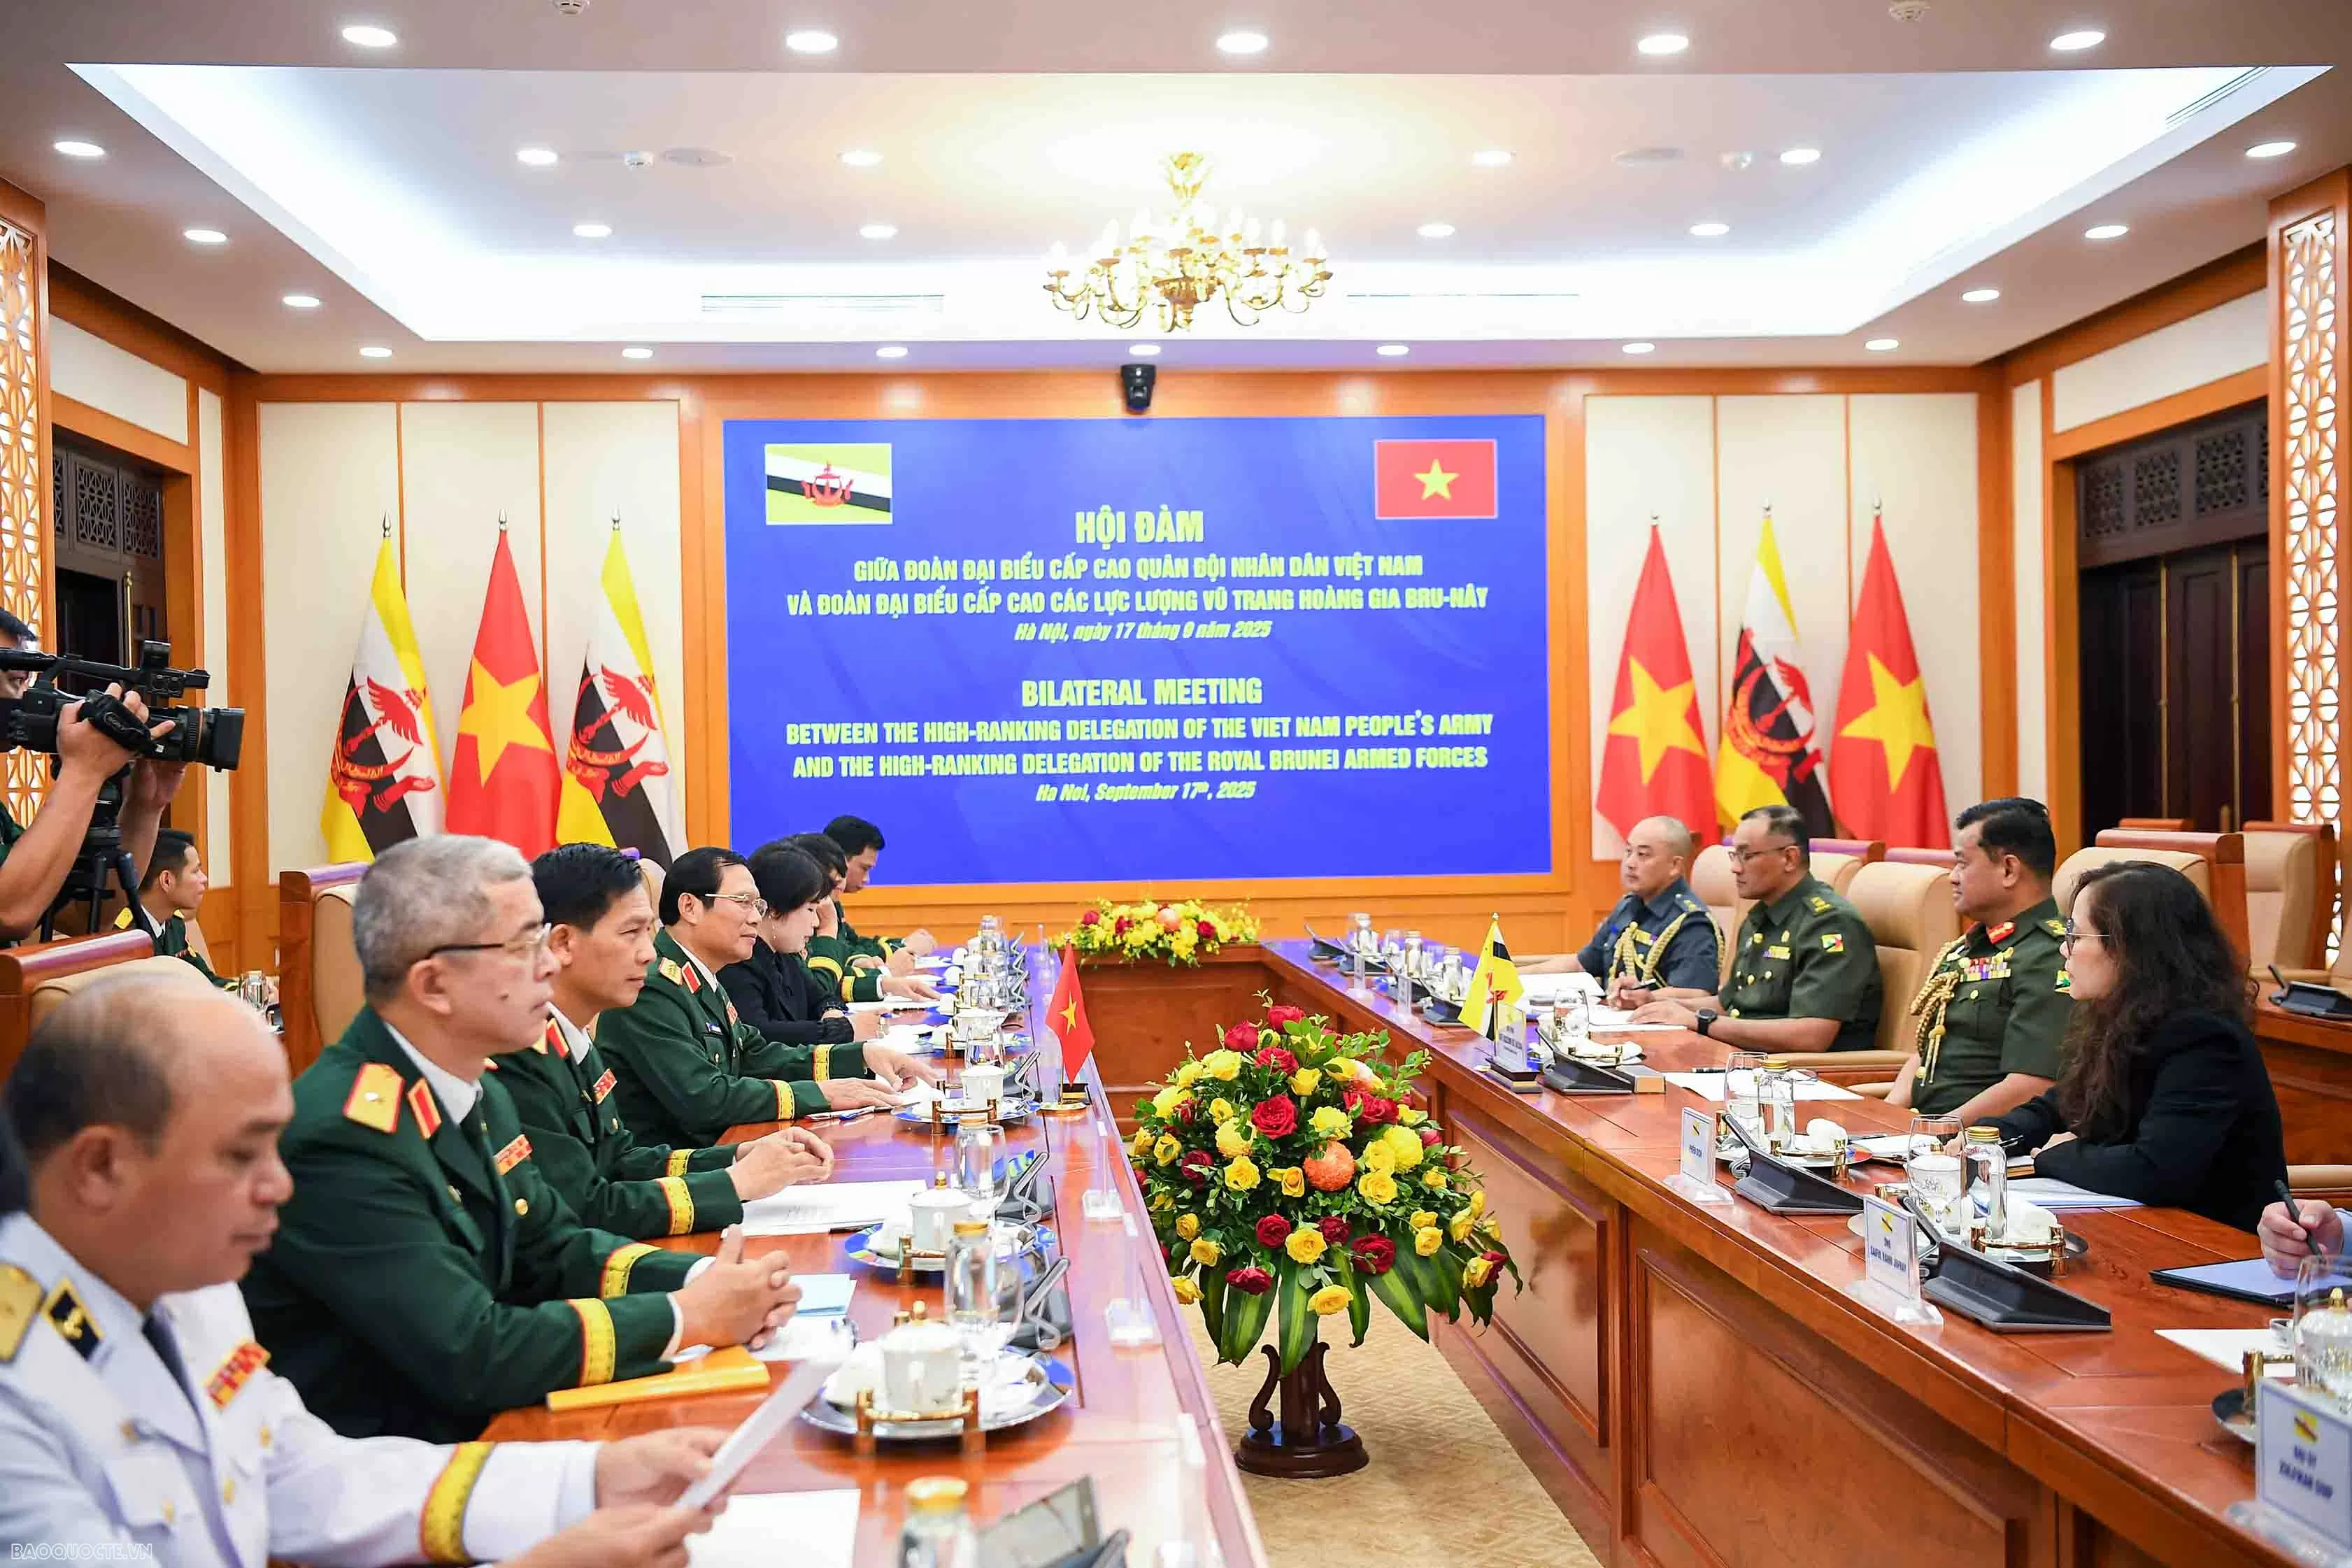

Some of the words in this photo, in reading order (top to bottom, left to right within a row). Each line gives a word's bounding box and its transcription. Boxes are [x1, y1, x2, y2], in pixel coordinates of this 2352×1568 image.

[1076, 504, 1127, 550] HỘI
[1134, 504, 1204, 543] ĐÀM
[854, 557, 900, 582] GIỮA
[904, 556, 958, 580] ĐOÀN
[962, 560, 996, 585] ĐẠI
[1000, 551, 1045, 580] BIỂU
[1050, 552, 1089, 580] CẤP
[1093, 558, 1132, 579] CAO
[1136, 554, 1190, 580] QUÂN
[1192, 553, 1227, 582] ĐỘI
[1231, 553, 1285, 578] NHÂN
[1290, 552, 1330, 577] DÂN
[1333, 551, 1374, 580] VIỆT
[1378, 555, 1423, 576] NAM
[787, 590, 813, 615] VÀ
[817, 590, 871, 615] ĐOÀN
[876, 593, 909, 618] ĐẠI
[914, 585, 958, 614] BIỂU
[963, 586, 1002, 613] CẤP
[1007, 592, 1046, 613] CAO
[1050, 587, 1090, 613] CÁC
[1094, 589, 1131, 615] LỰC
[1135, 589, 1198, 615] LƯỢNG
[1203, 586, 1228, 611] VŨ
[1232, 589, 1295, 610] TRANG
[1299, 585, 1364, 610] HOÀNG
[1369, 588, 1402, 609] GIA
[1405, 583, 1489, 608] BRU-NÂY
[1014, 623, 1037, 640] Hà
[1073, 622, 1113, 641] ngày
[1116, 622, 1136, 639] 17
[1136, 621, 1181, 641] tháng
[1195, 621, 1232, 638] năm
[1232, 620, 1274, 638] 2025
[1022, 679, 1148, 706] BILATERAL
[1154, 677, 1262, 705] MEETING
[787, 723, 878, 744] BETWEEN
[883, 722, 919, 743] THE
[924, 720, 1062, 742] HIGH-RANKING
[1067, 719, 1178, 740] DELEGATION
[1183, 718, 1208, 739] OF
[1211, 718, 1247, 738] THE
[1251, 717, 1292, 737] VIET
[1296, 716, 1341, 737] NAM
[1439, 714, 1493, 735] ARMY
[793, 757, 834, 778] AND
[839, 756, 874, 777] THE
[880, 754, 1018, 776] HIGH-RANKING
[1022, 752, 1135, 774] DELEGATION
[1140, 752, 1164, 772] OF
[1167, 751, 1203, 771] THE
[1208, 750, 1266, 771] ROYAL
[1269, 749, 1340, 770] BRUNEI
[1344, 748, 1411, 769] ARMED
[1416, 746, 1488, 768] FORCES
[1036, 784, 1058, 801] Ha
[1095, 783, 1180, 801] September
[1216, 781, 1257, 798] 2025
